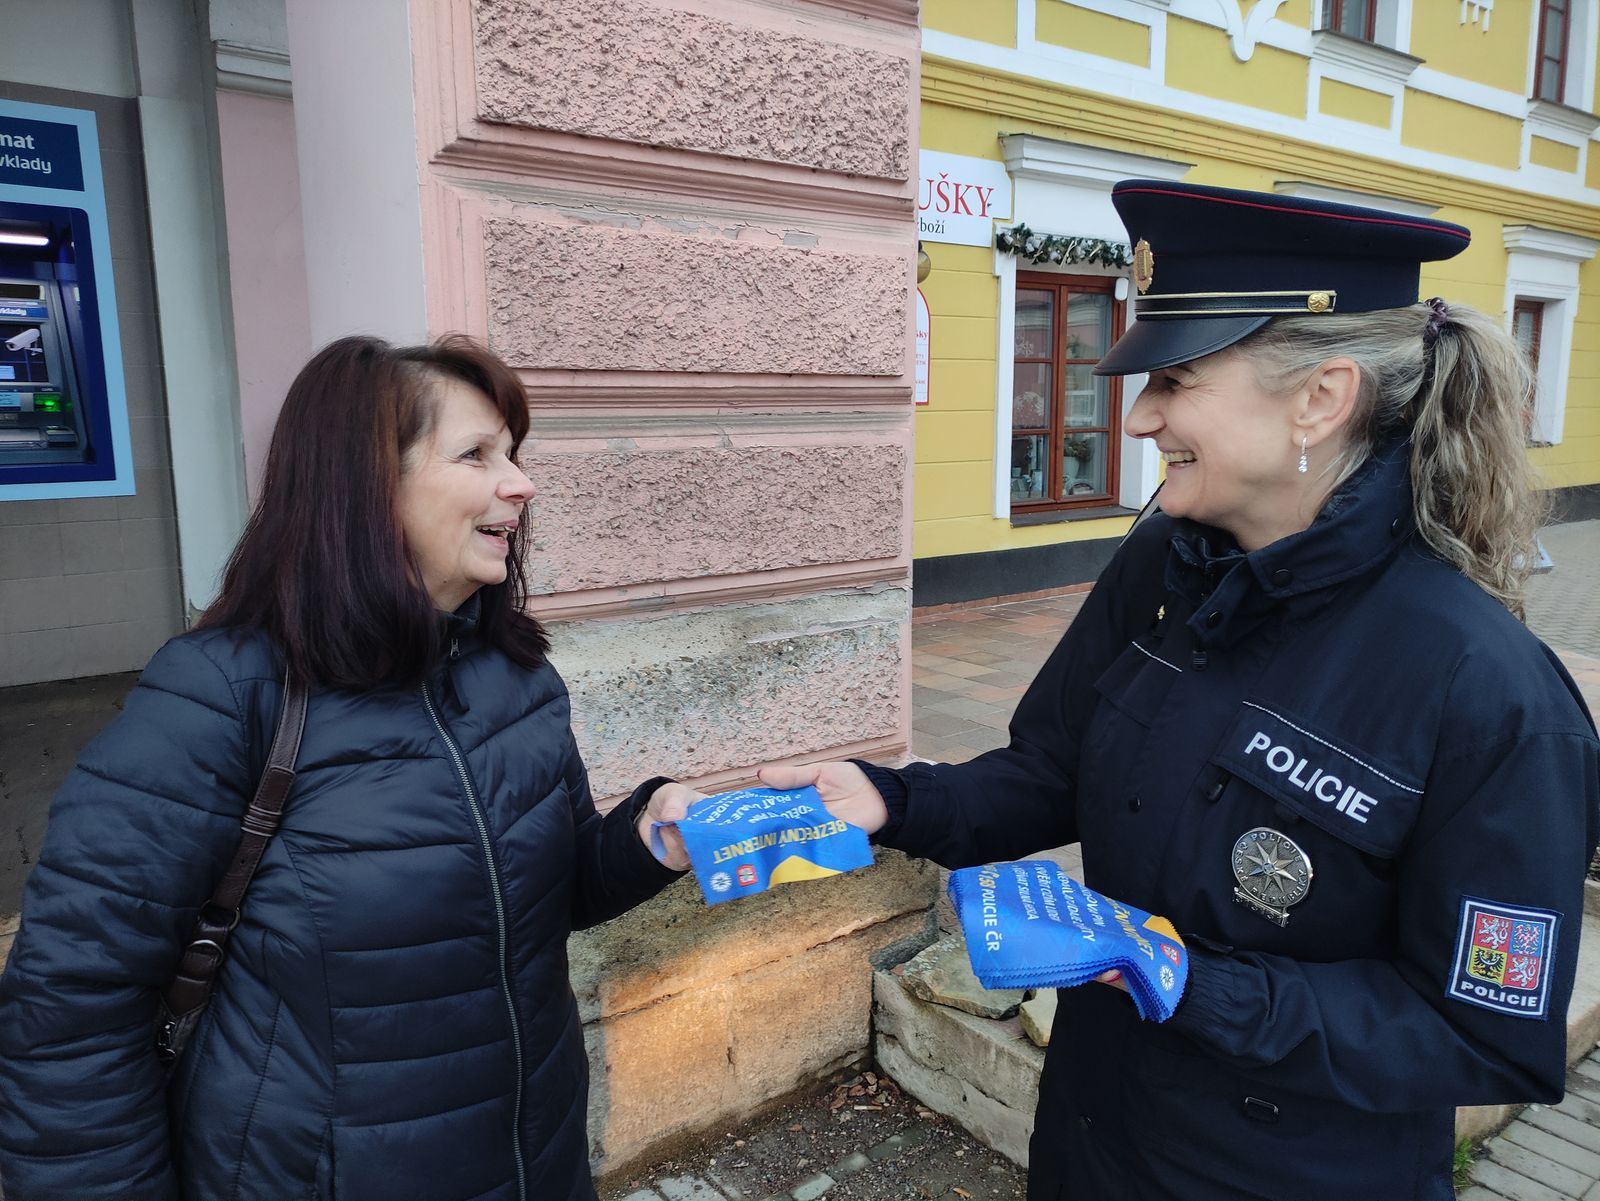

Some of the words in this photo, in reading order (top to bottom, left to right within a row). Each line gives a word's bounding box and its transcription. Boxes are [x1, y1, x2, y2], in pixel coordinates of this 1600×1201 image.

[1244, 731, 1379, 824] POLICIE
[714, 832, 778, 864] INTERNET
[981, 888, 998, 927] POLICIE
[985, 930, 1003, 952] ČR
[1460, 980, 1538, 1007] POLICIE
